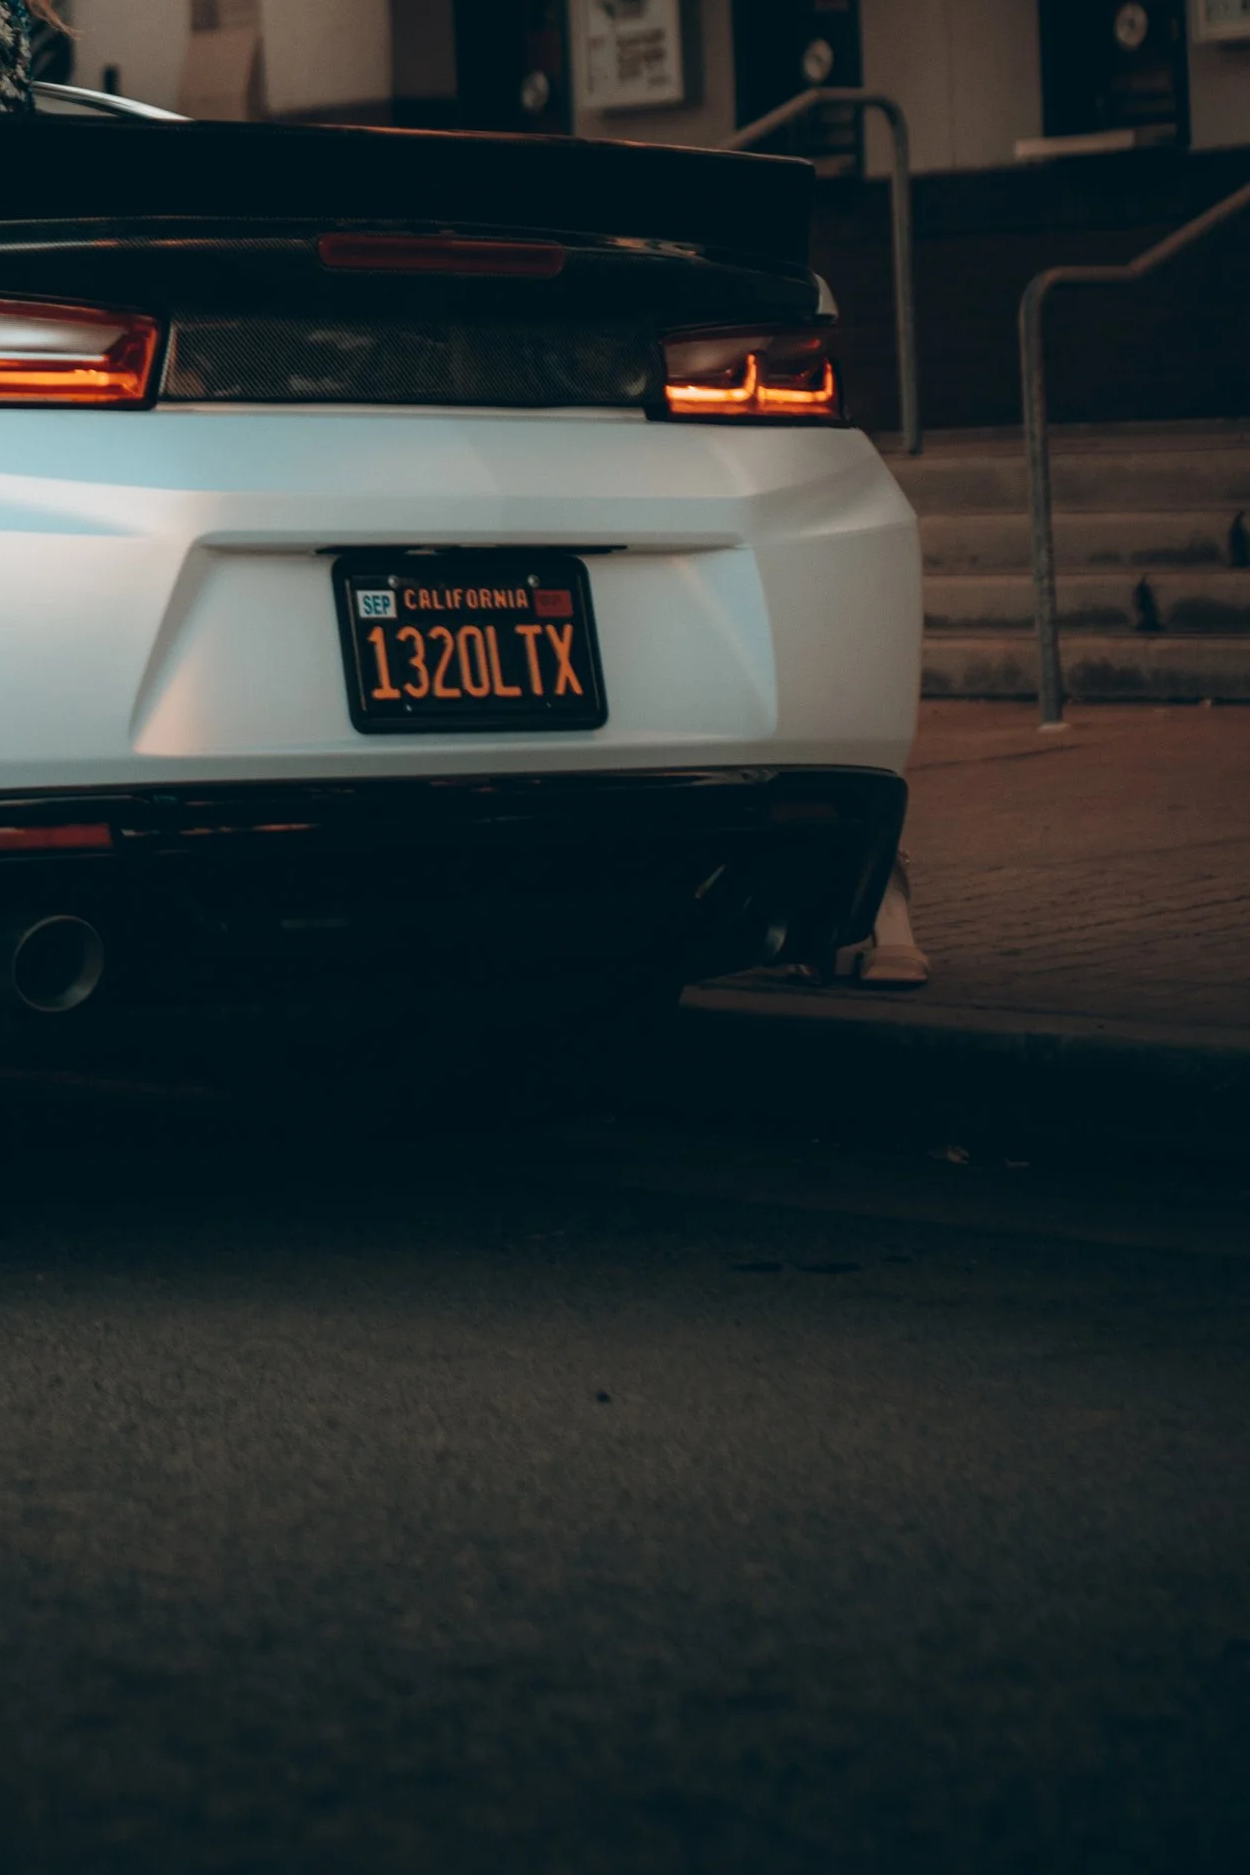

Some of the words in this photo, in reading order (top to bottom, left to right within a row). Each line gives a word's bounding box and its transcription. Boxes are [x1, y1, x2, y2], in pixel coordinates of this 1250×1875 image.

[362, 594, 391, 615] SEP
[404, 588, 529, 610] CALIFORNIA
[368, 623, 584, 699] 1320LTX
